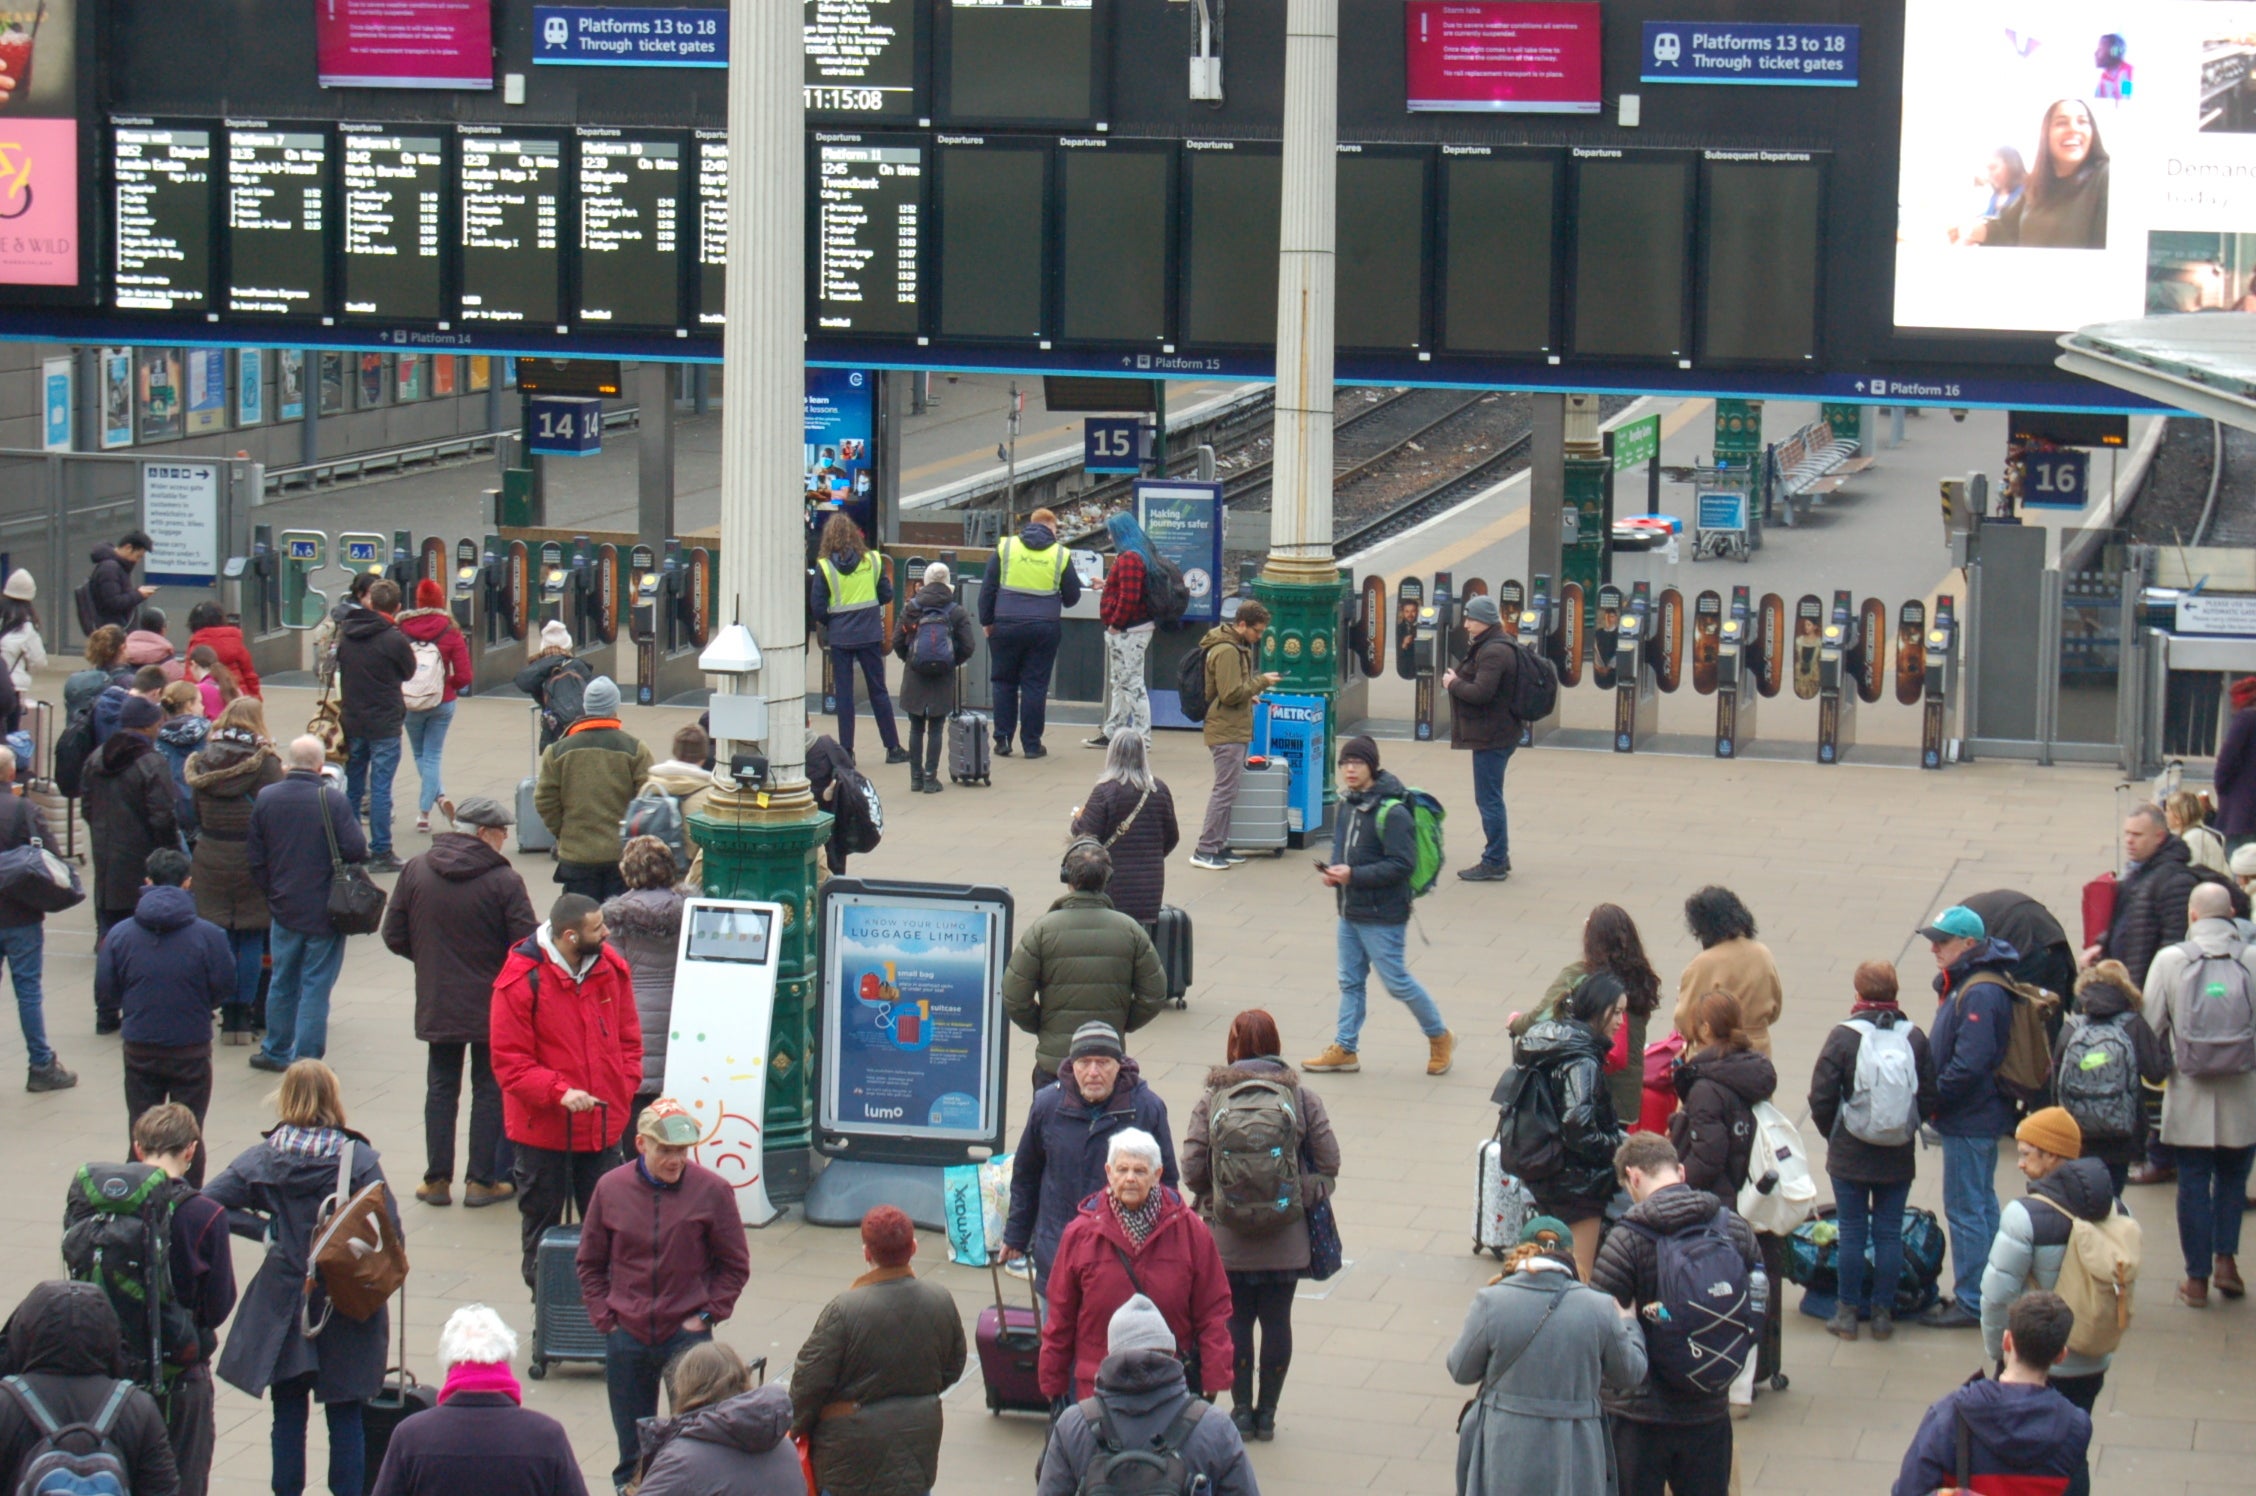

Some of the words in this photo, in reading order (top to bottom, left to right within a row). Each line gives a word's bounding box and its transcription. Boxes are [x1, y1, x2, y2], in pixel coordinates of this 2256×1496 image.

[578, 17, 650, 34] Platforms
[654, 19, 673, 34] 13
[676, 21, 693, 35] to
[697, 20, 717, 35] 18
[579, 37, 632, 54] Through
[639, 38, 676, 53] ticket
[679, 41, 715, 55] gates
[1692, 33, 1771, 51] Platforms
[1776, 35, 1797, 51] 13
[1801, 37, 1820, 52] to
[1824, 36, 1846, 52] 18
[1692, 54, 1751, 71] Through
[1759, 55, 1800, 70] ticket
[1803, 57, 1843, 73] gates
[803, 89, 883, 110] 11:15:08
[339, 123, 383, 133] Departures
[457, 125, 502, 135] Departures
[576, 127, 621, 137] Departures
[695, 130, 728, 141] Departu
[816, 133, 861, 143] Departures
[937, 135, 984, 145] Departures
[1060, 137, 1107, 147] Departures
[582, 141, 627, 154] Platform
[630, 143, 642, 155] 10
[1187, 139, 1234, 149] Departures
[1336, 144, 1362, 153] rtures
[1443, 145, 1491, 155] Departures
[821, 147, 867, 160] Platform
[871, 150, 882, 161] 11
[1573, 148, 1622, 158] Departures
[1705, 150, 1758, 161] Subsequent
[1760, 152, 1810, 162] Departures
[638, 157, 653, 170] On
[655, 158, 679, 170] time
[878, 163, 894, 176] On
[896, 164, 920, 176] time
[821, 176, 879, 189] Tweedbank
[29, 238, 70, 255] WILD
[411, 332, 455, 343] Platform
[458, 334, 471, 344] 14
[1155, 357, 1203, 369] Platform
[1206, 359, 1220, 370] 15
[1890, 382, 1942, 396] Platform
[1944, 384, 1960, 396] 16
[539, 412, 574, 439] 14
[584, 412, 599, 439] 14
[1093, 428, 1130, 457] 15
[2035, 463, 2076, 492] 16
[1150, 509, 1181, 520] Making
[1150, 519, 1185, 530] journeys
[1187, 520, 1208, 529] safer
[865, 918, 897, 926] KNOW
[903, 919, 931, 928] YOUR
[936, 921, 966, 930] LUMO
[851, 928, 921, 940] LUGGAGE
[929, 932, 978, 943] LIMITS
[884, 962, 895, 982] 1
[897, 970, 918, 978] small
[920, 971, 934, 979] bag
[917, 1000, 929, 1019] 1
[930, 1004, 961, 1013] suitcase
[875, 1002, 896, 1030] &
[864, 1103, 904, 1119] lumo
